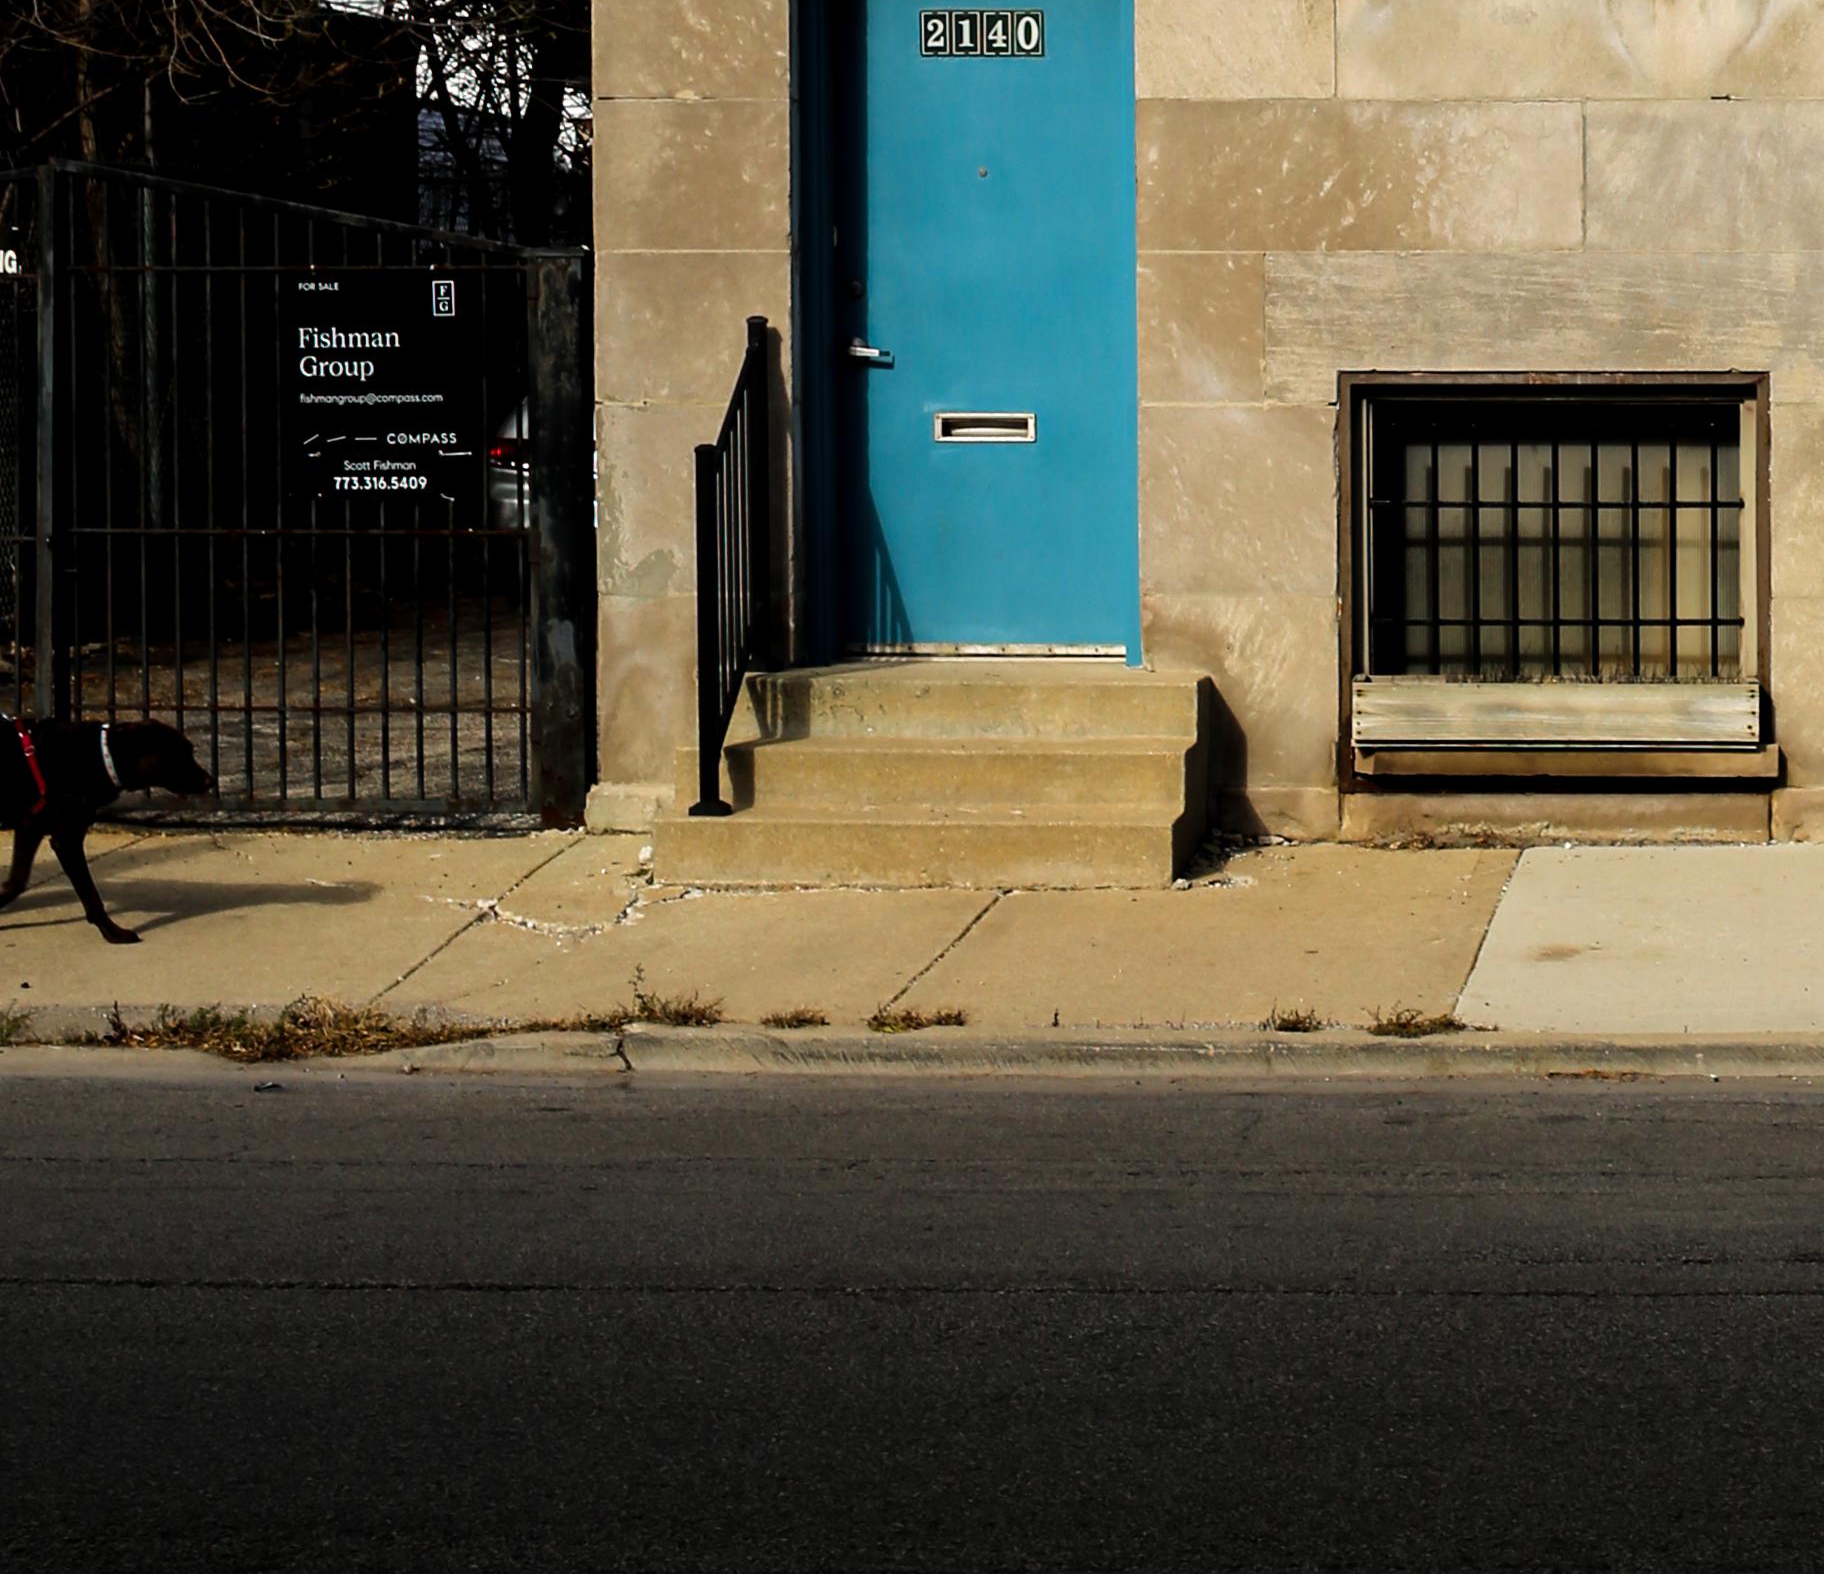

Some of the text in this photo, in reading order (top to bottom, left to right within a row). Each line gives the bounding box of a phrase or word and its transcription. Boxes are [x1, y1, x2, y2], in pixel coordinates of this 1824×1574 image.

[926, 16, 1039, 51] 2140
[298, 282, 339, 291] FOR SALE
[298, 327, 400, 348] Fishman
[299, 356, 375, 382] Group
[299, 393, 443, 405] fishmangroup@compass.com
[386, 433, 457, 444] COMPASS
[343, 460, 417, 471] Scott Fishman
[333, 477, 428, 490] 773.316.5409
